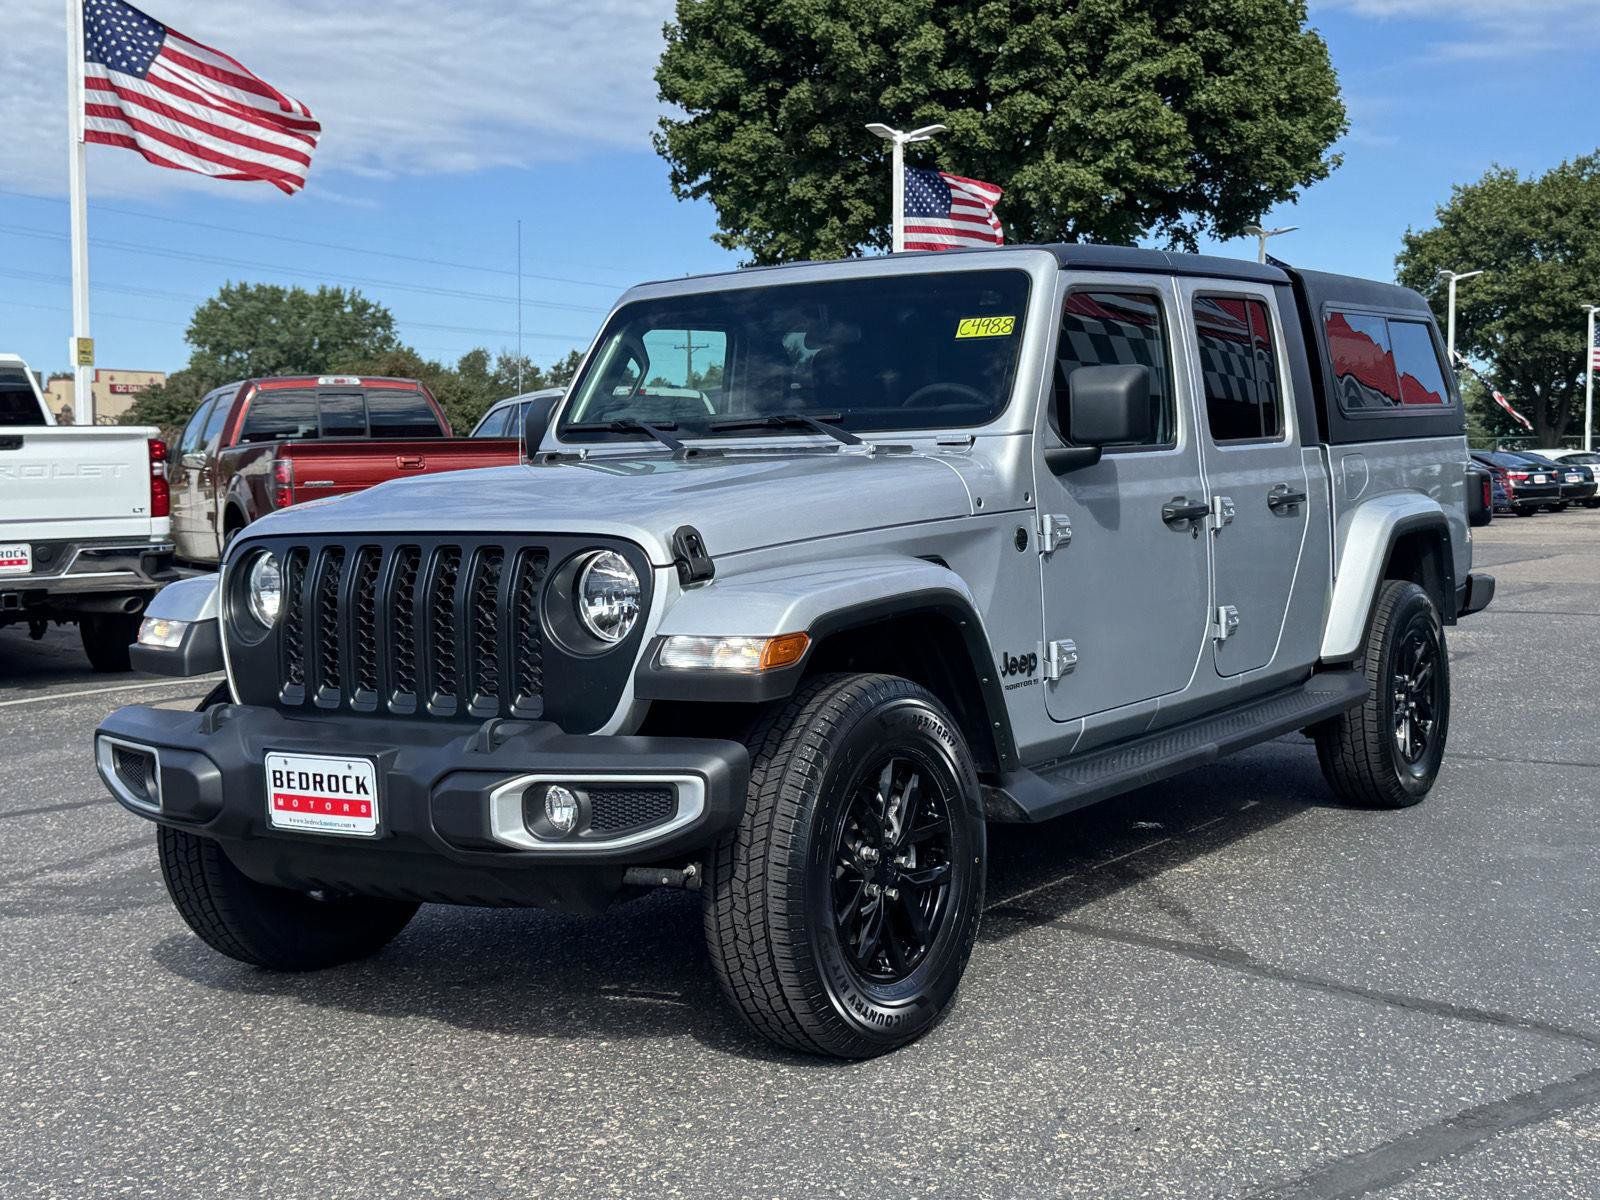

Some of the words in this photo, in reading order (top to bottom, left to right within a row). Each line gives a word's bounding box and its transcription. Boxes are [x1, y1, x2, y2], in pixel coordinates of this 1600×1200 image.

[959, 317, 1014, 335] C4988
[999, 651, 1038, 678] Jeep
[272, 770, 370, 795] BEDROCK
[277, 797, 368, 814] MOTORS
